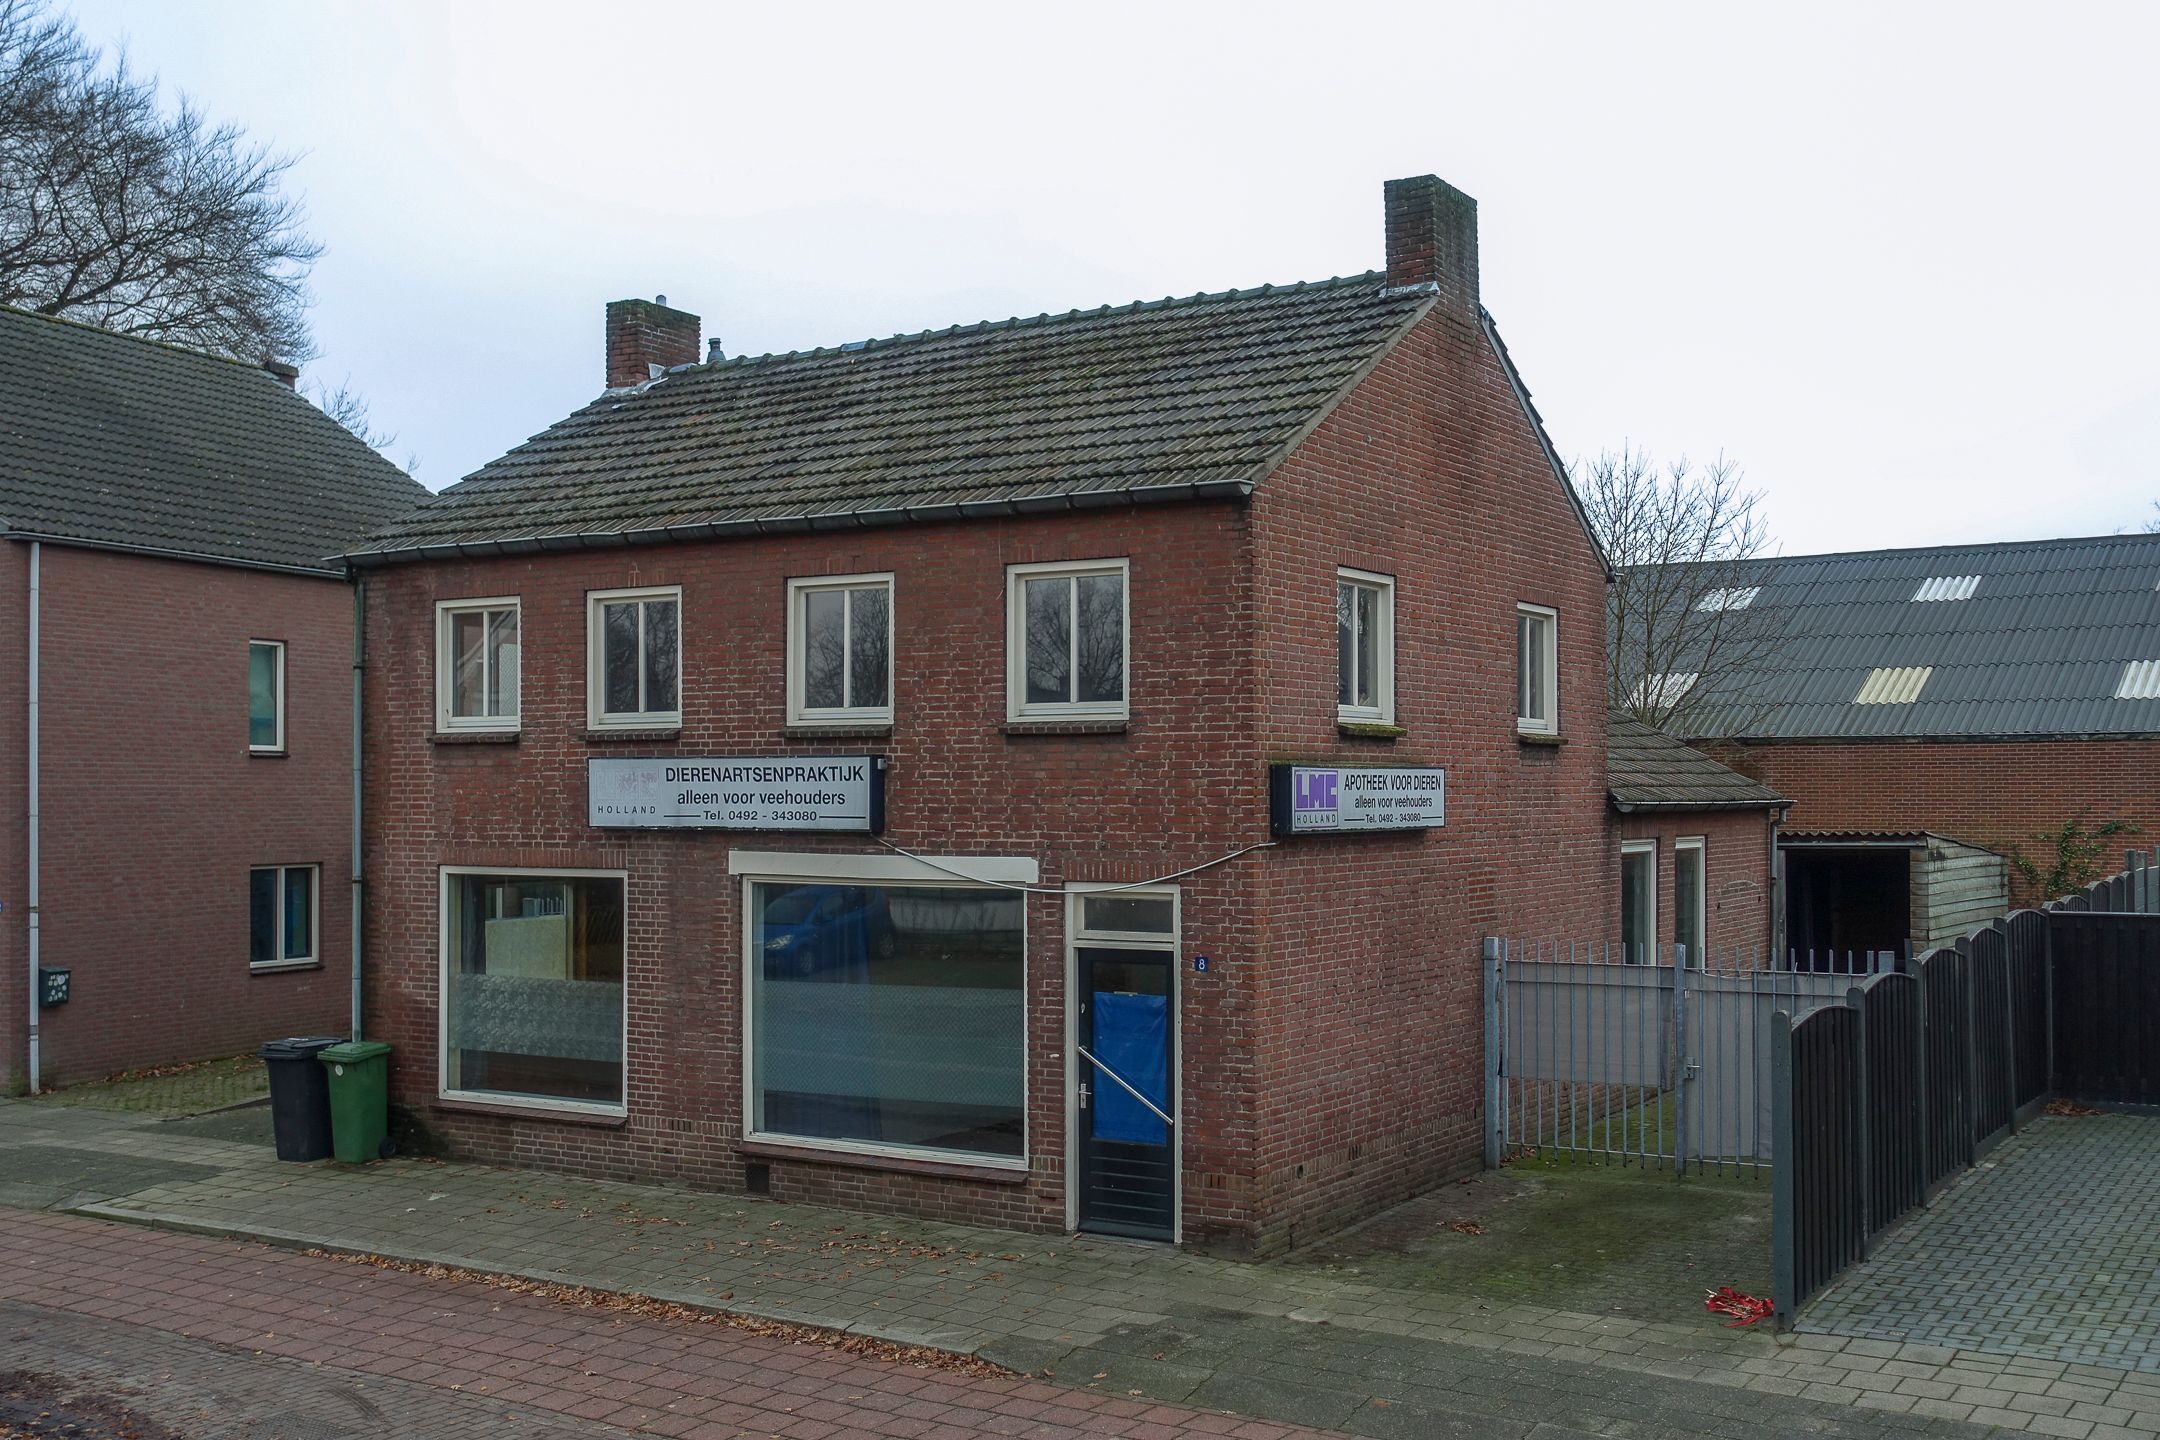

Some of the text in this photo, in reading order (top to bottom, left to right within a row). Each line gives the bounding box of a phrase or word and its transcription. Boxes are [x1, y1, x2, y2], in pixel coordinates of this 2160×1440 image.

[665, 766, 864, 782] DIERENARTSENPRAKTIJK
[1344, 775, 1441, 790] APOTHEEK VOOR DIEREN
[678, 790, 846, 804] alleen voor veehouders
[1355, 795, 1432, 808] alleen voor veehouders
[598, 806, 656, 814] HOLLAND
[703, 810, 724, 820] Tel.
[728, 811, 758, 820] 0492
[771, 811, 817, 821] 343080
[1297, 815, 1336, 824] HOLLAND
[1366, 815, 1377, 823] Tel.
[1378, 814, 1393, 822] 0492
[1399, 813, 1421, 822] 343080
[1199, 959, 1205, 969] 8
